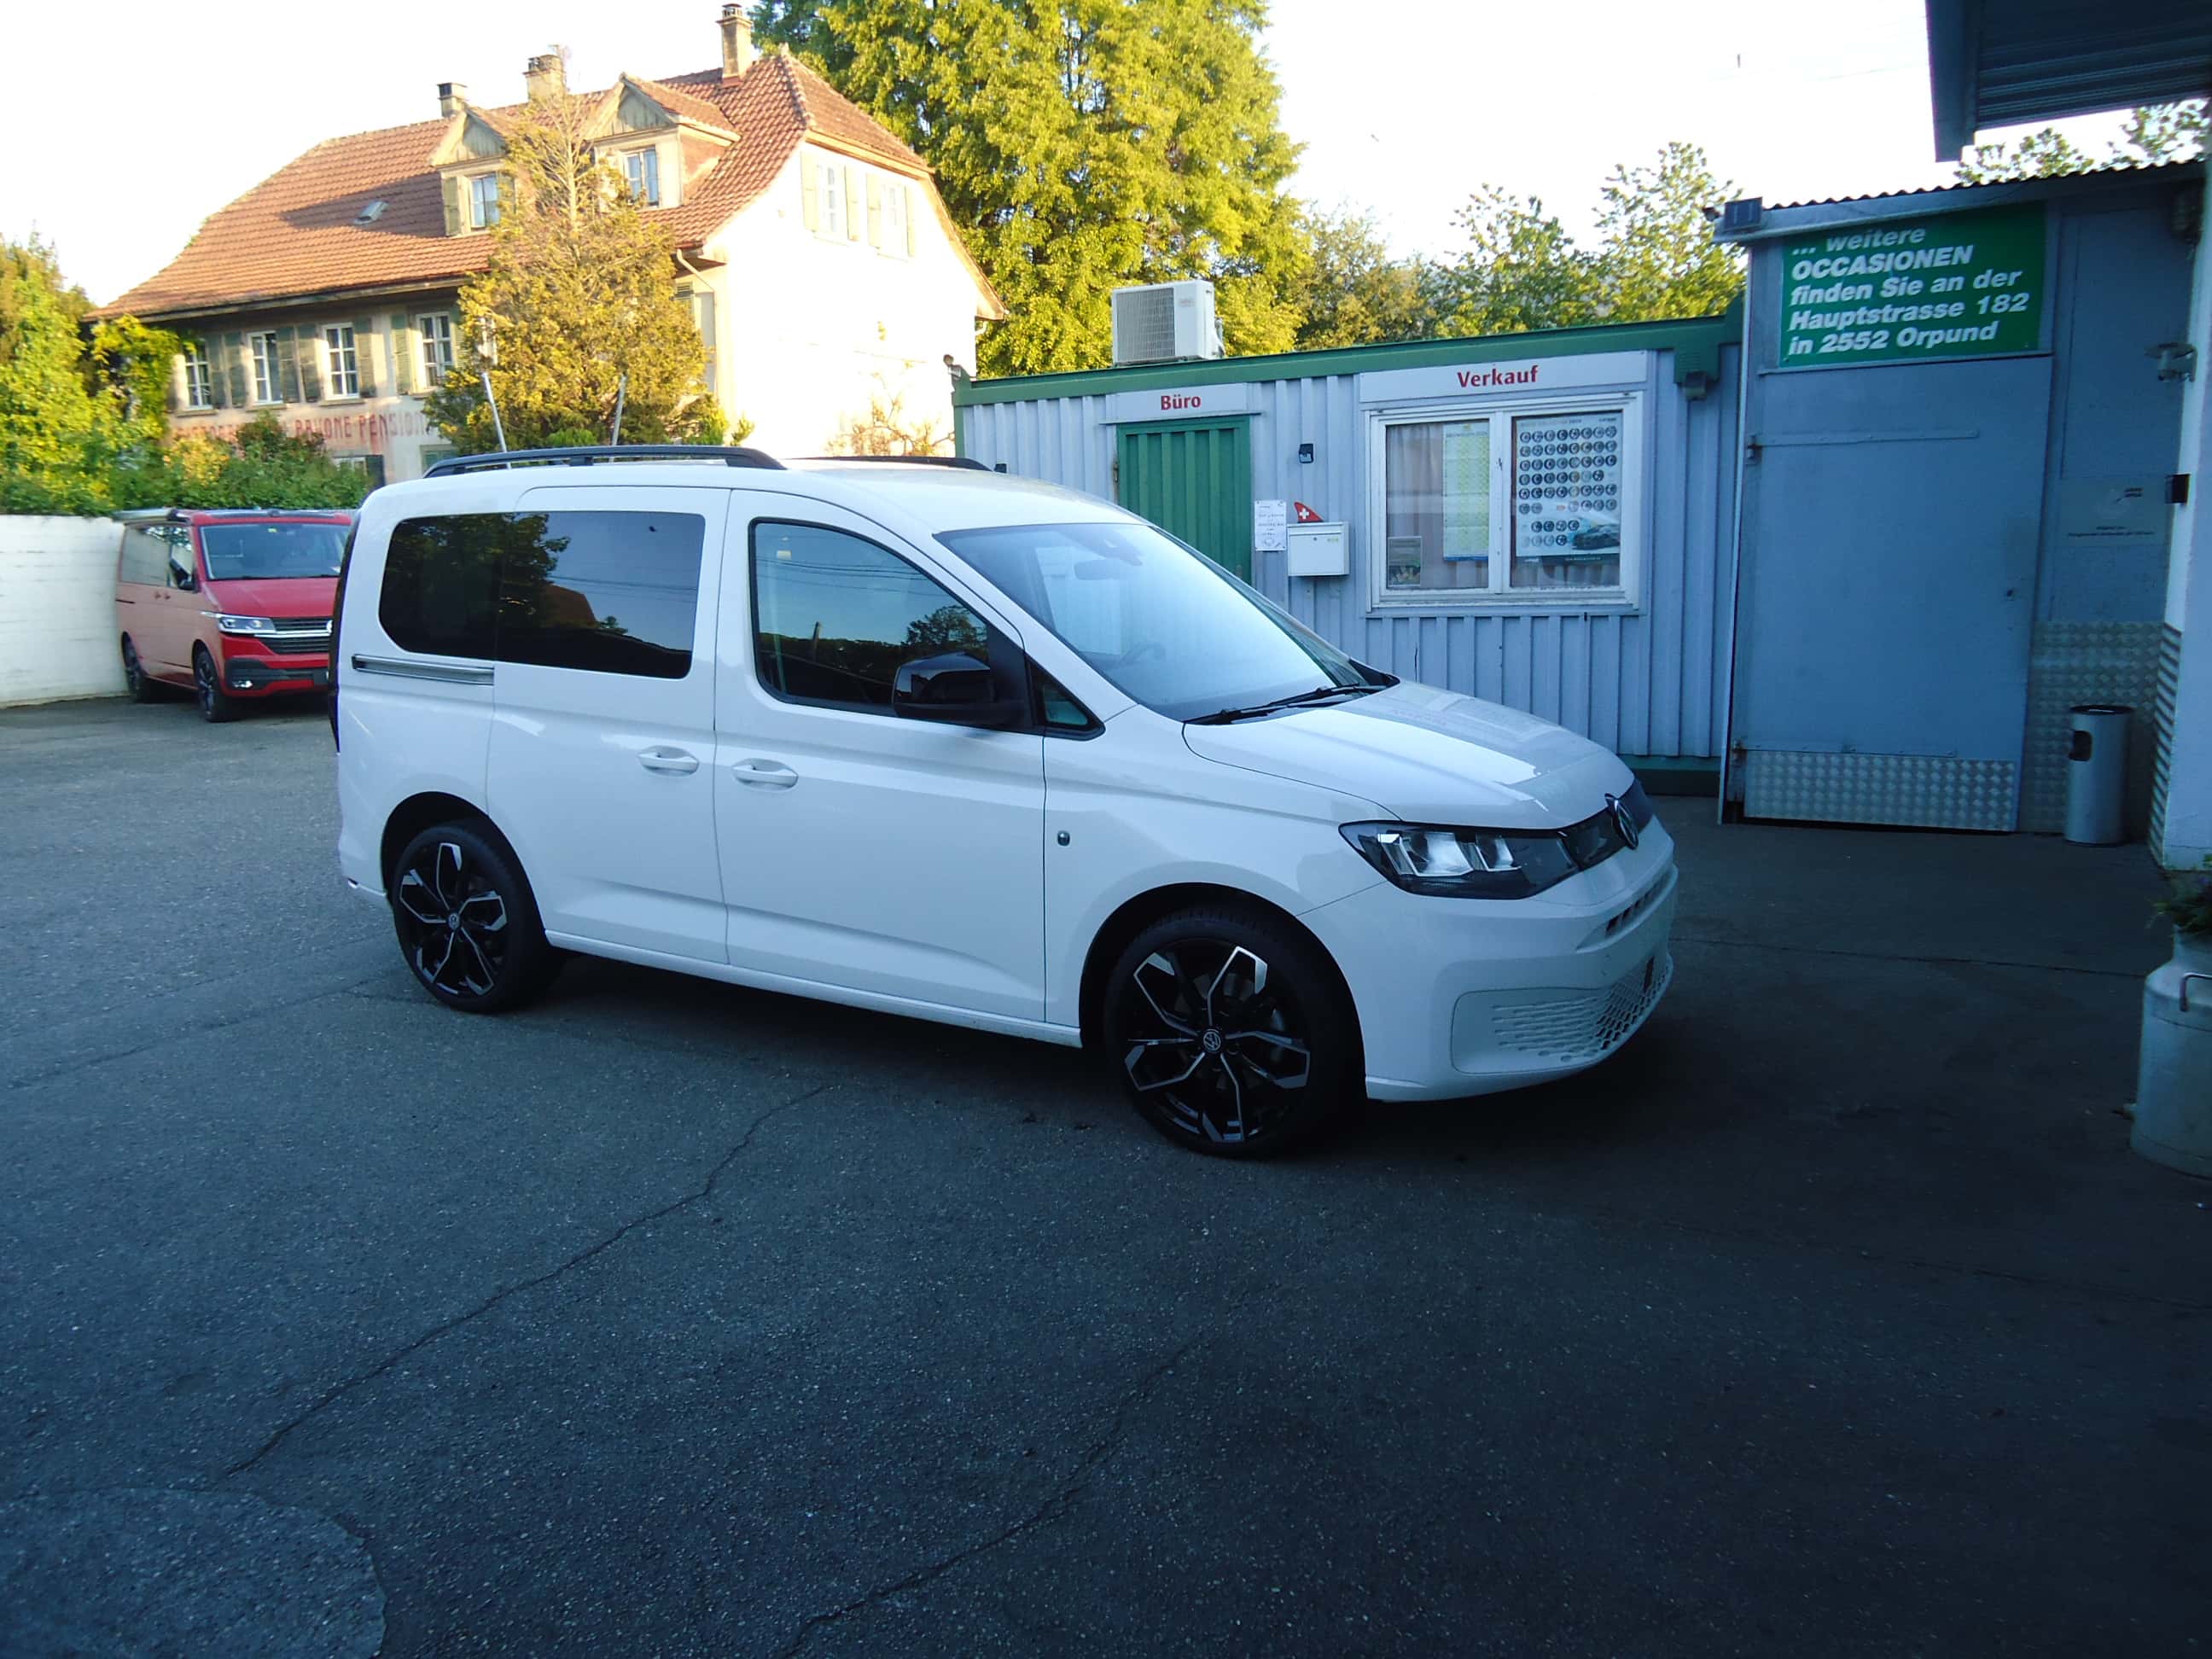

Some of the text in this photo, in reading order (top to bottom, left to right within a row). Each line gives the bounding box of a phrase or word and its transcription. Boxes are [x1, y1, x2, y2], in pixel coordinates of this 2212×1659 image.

[1826, 229, 1924, 252] weitere
[1792, 245, 1973, 280] OCCASIONEN
[1790, 268, 2023, 305] finden Sie an der
[1790, 292, 2030, 330] Hauptstrasse 182
[1789, 320, 2000, 356] in 2552 Orpund
[1457, 364, 1539, 388] Verkauf
[1161, 393, 1202, 410] Büro
